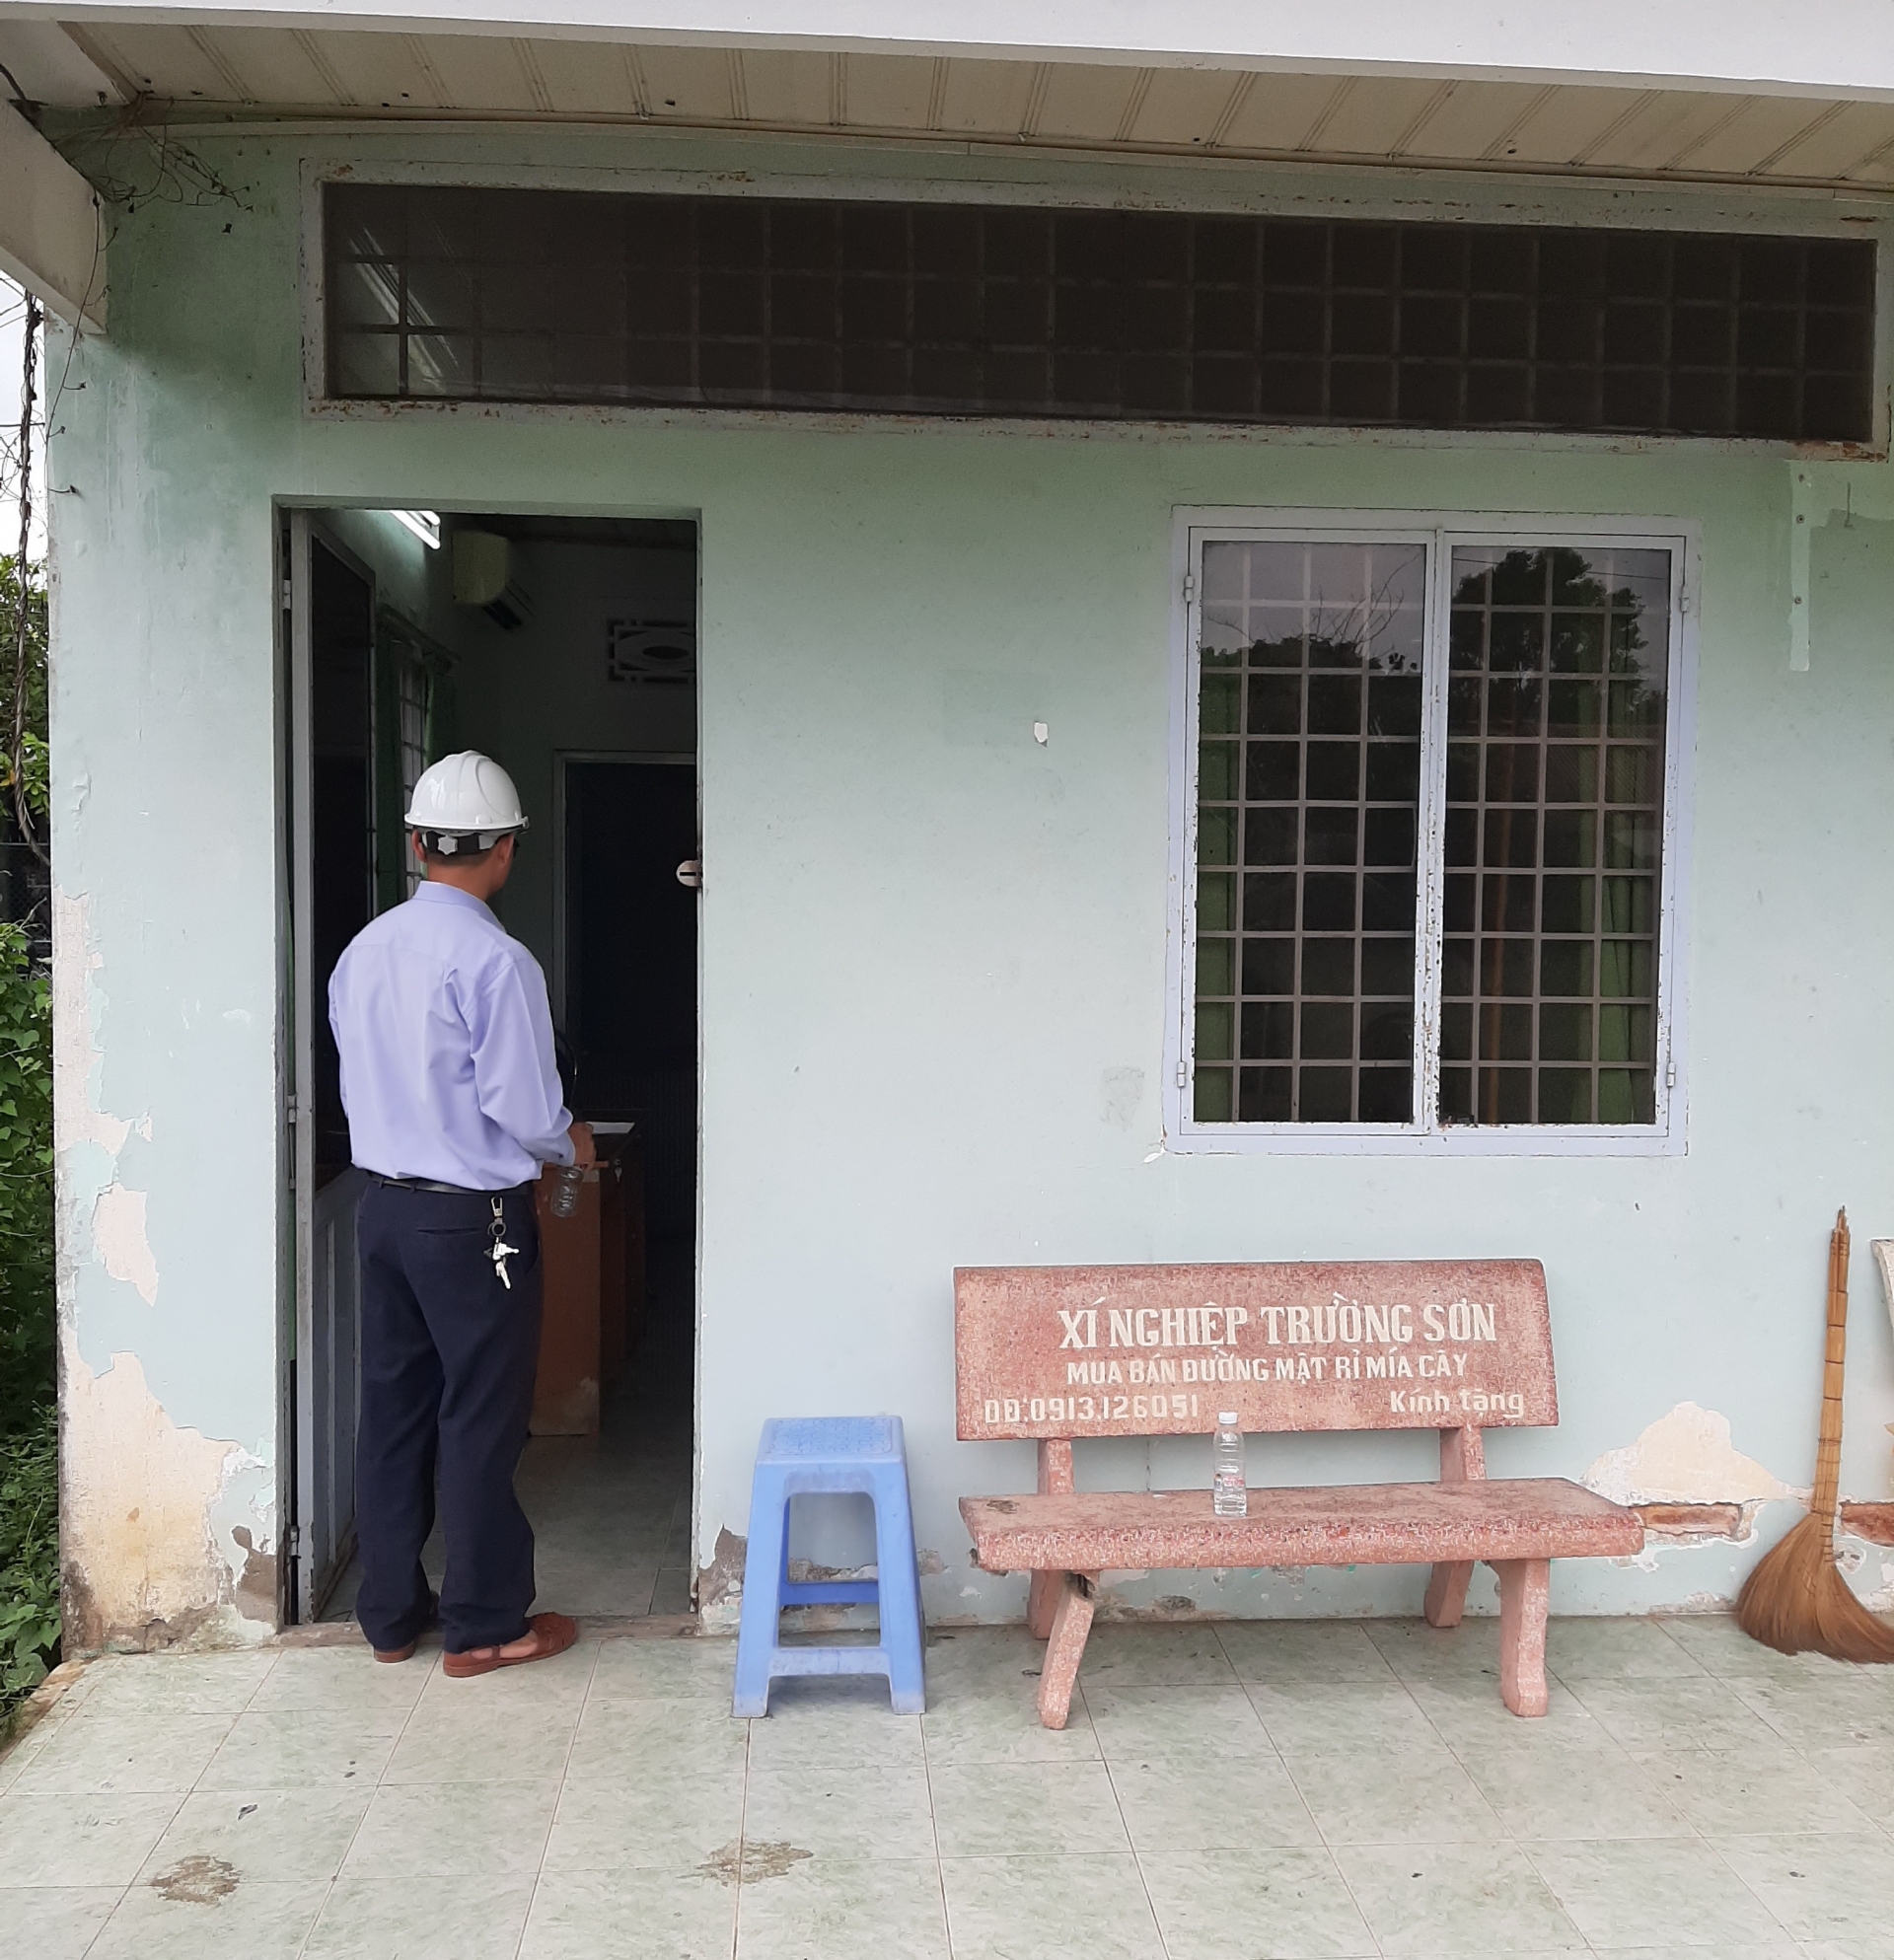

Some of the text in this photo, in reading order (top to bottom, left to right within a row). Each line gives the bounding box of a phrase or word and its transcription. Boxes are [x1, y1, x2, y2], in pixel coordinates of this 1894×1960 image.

[1056, 1291, 1496, 1351] XÍ NGHIỆP TRƯỜNG SƠN
[1067, 1361, 1123, 1385] MUA
[1129, 1353, 1176, 1383] BÁN
[1184, 1348, 1270, 1382] ĐƯỜNG
[1275, 1351, 1328, 1385] MẬT
[1365, 1345, 1415, 1379] MÍA
[1419, 1349, 1468, 1377] CÂY
[1389, 1387, 1525, 1419] Kính tặng
